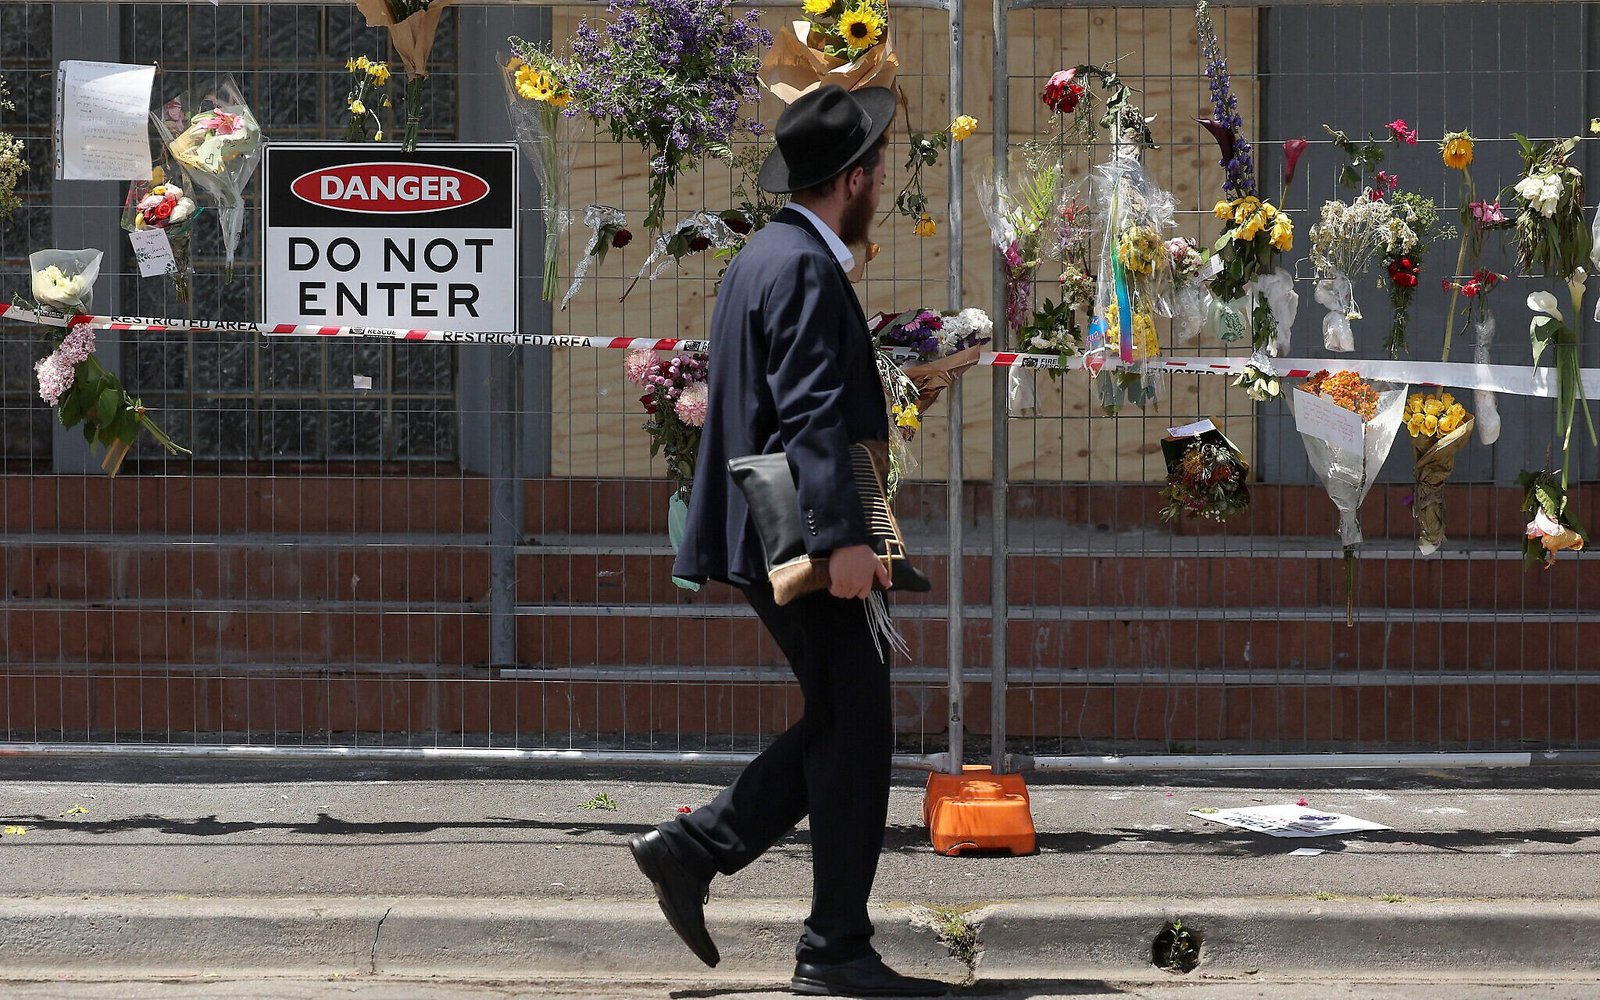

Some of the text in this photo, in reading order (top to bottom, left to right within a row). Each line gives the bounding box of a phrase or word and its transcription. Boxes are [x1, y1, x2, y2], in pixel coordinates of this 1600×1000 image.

[320, 175, 463, 201] DANGER
[288, 236, 494, 273] DO NOT
[299, 281, 480, 318] ENTER
[111, 315, 259, 331] RESTRICTED AREA
[443, 331, 592, 347] RESTRICTED AREA
